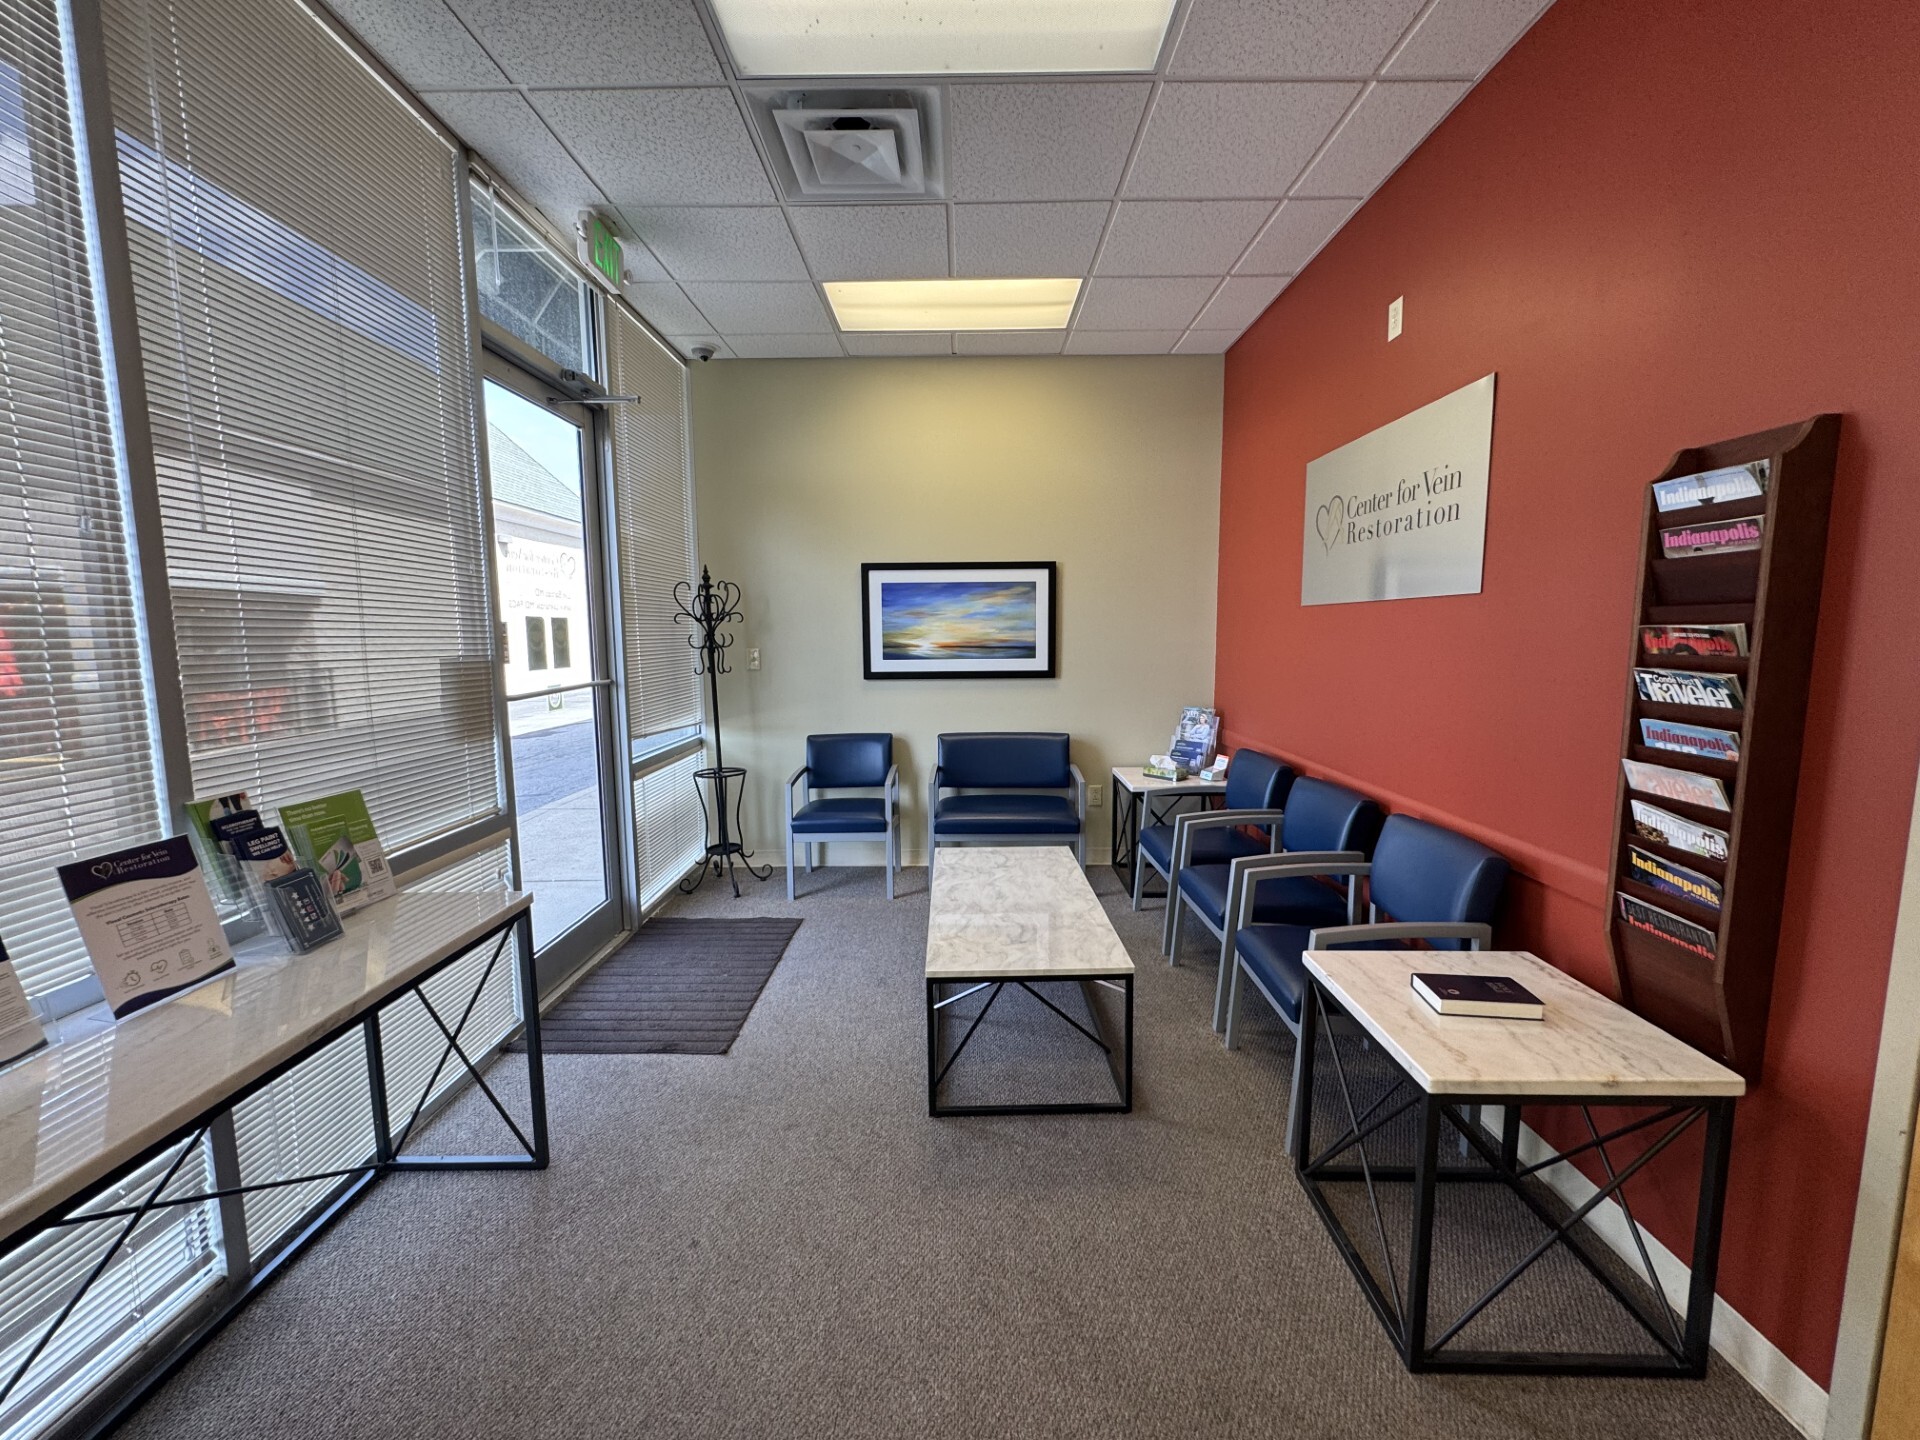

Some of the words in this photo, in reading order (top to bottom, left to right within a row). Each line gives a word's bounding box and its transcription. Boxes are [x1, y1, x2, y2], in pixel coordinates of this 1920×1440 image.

[594, 219, 621, 285] EXIT
[1347, 490, 1393, 519] Center
[1397, 478, 1420, 505] for
[1423, 464, 1462, 496] Vein
[1660, 477, 1753, 506] Indianapolis
[1347, 501, 1460, 545] Restoration
[1664, 523, 1760, 548] Indianapolis
[1640, 673, 1733, 709] Traveler
[1645, 726, 1733, 752] Indianapolis
[247, 838, 261, 847] LEG
[261, 832, 279, 843] PAIN?
[249, 838, 281, 853] SWELLING?
[1635, 808, 1725, 855] Indianapolis
[113, 856, 141, 869] Center
[140, 852, 153, 863] for
[152, 849, 169, 860] Vein
[114, 855, 171, 875] Restoration
[1631, 852, 1720, 906] Indianapolis
